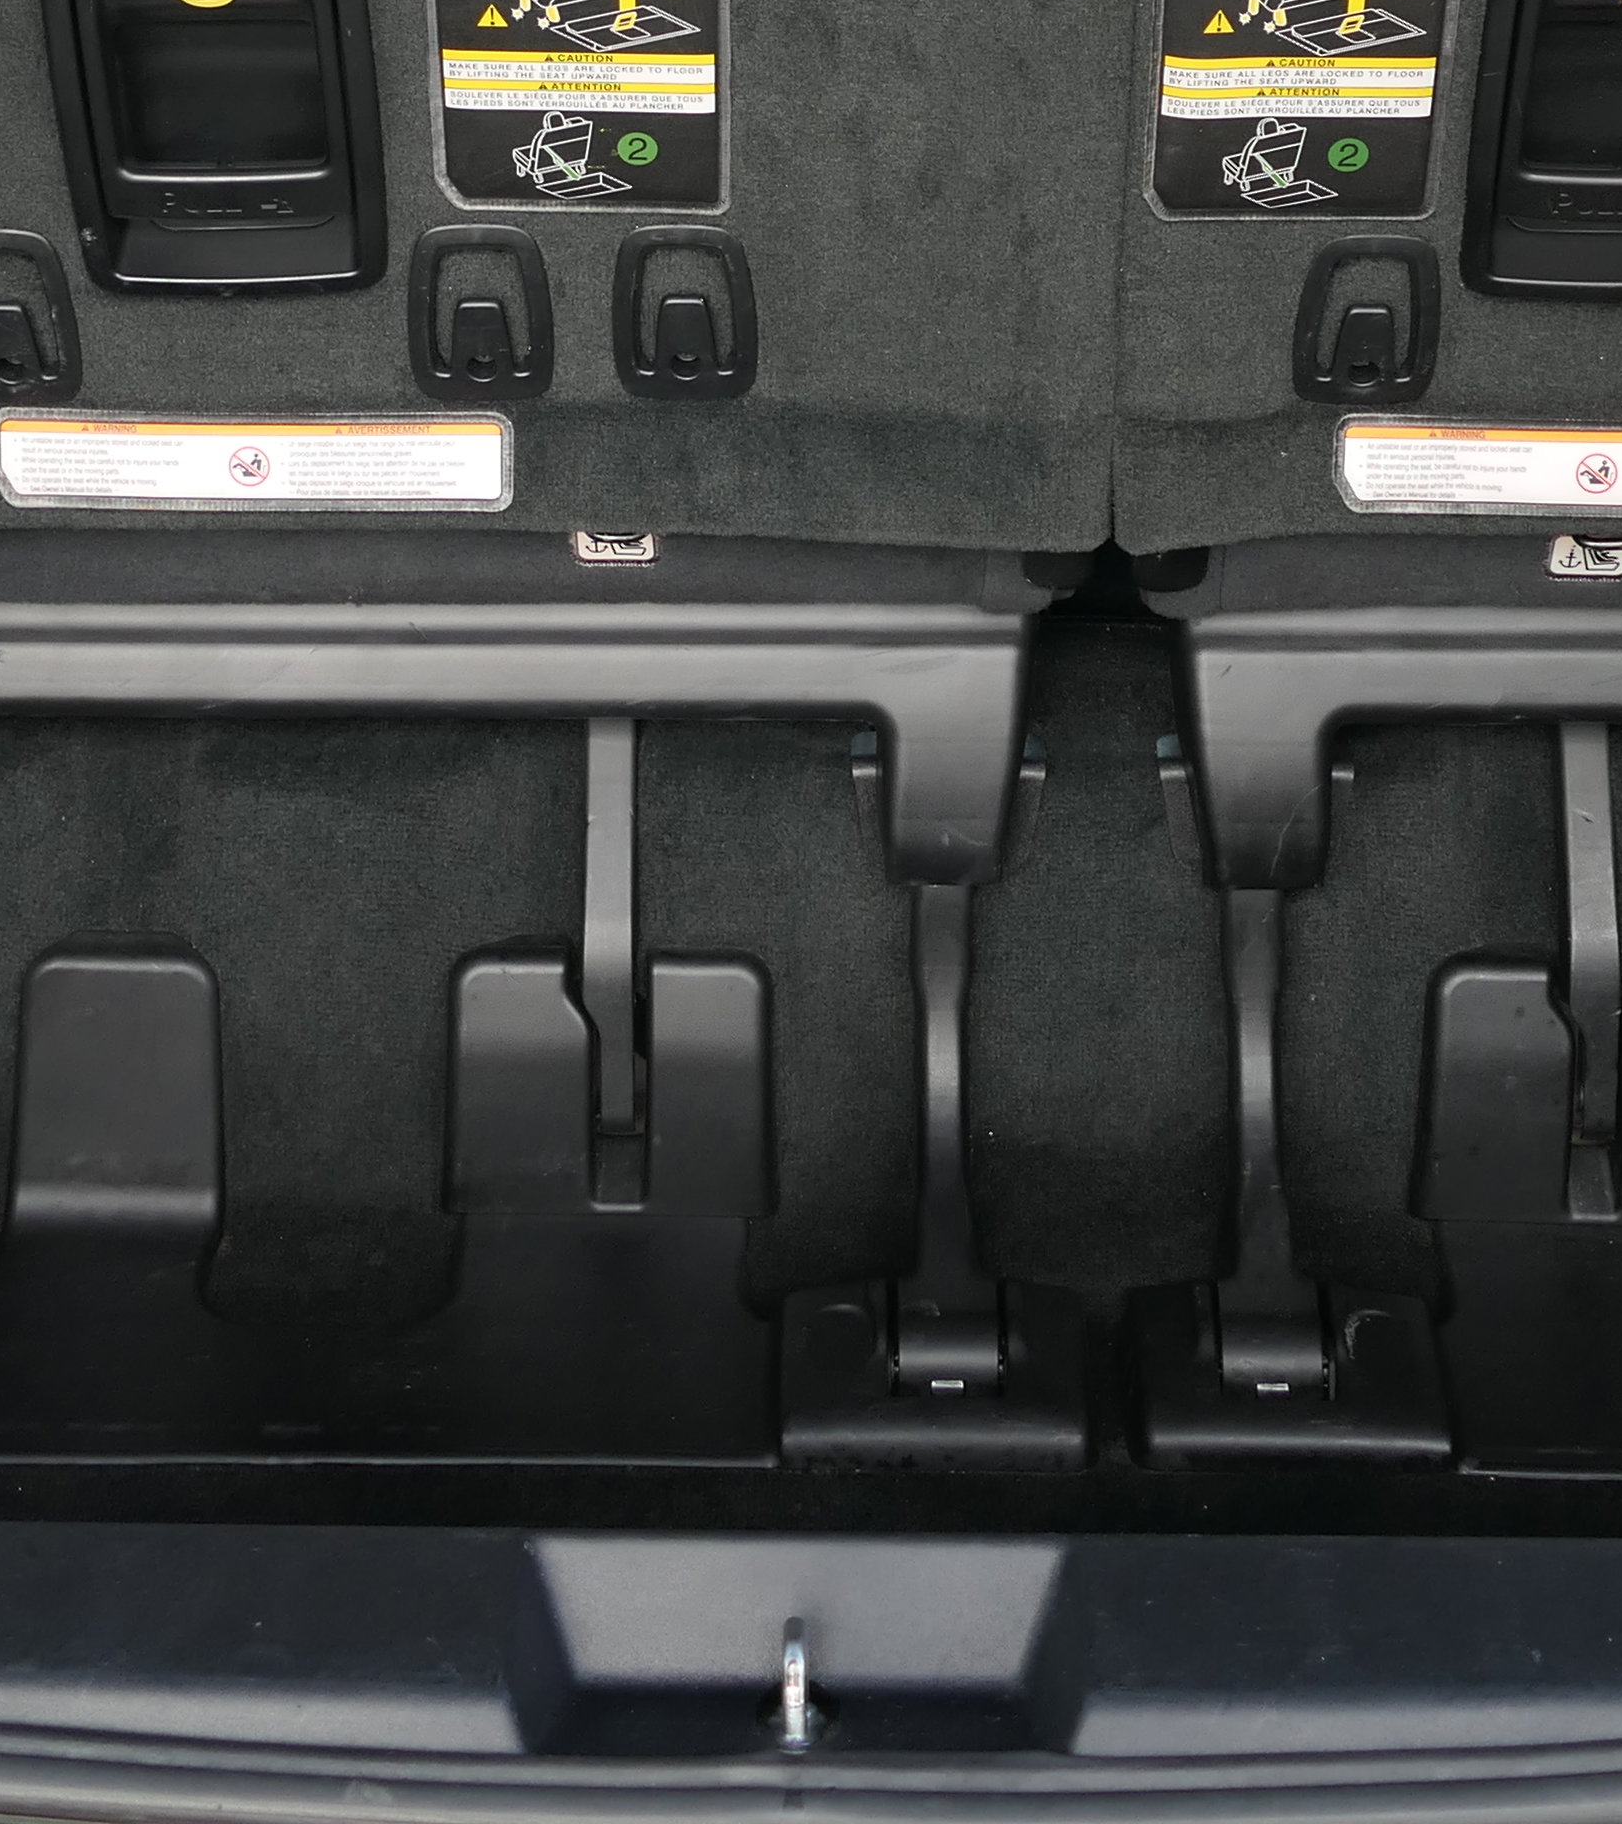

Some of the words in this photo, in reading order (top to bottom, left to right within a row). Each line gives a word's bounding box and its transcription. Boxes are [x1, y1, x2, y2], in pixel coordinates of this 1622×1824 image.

[557, 54, 613, 63] CAUTION
[1279, 59, 1336, 67] CAUTION
[551, 83, 621, 91] ATTENTION
[1269, 88, 1340, 96] ATTENTION
[628, 137, 647, 160] 2
[1338, 144, 1358, 167] 2
[93, 424, 137, 434] WARNING
[348, 426, 431, 434] AVERTISSEMENT
[1441, 430, 1486, 439] WARNING
